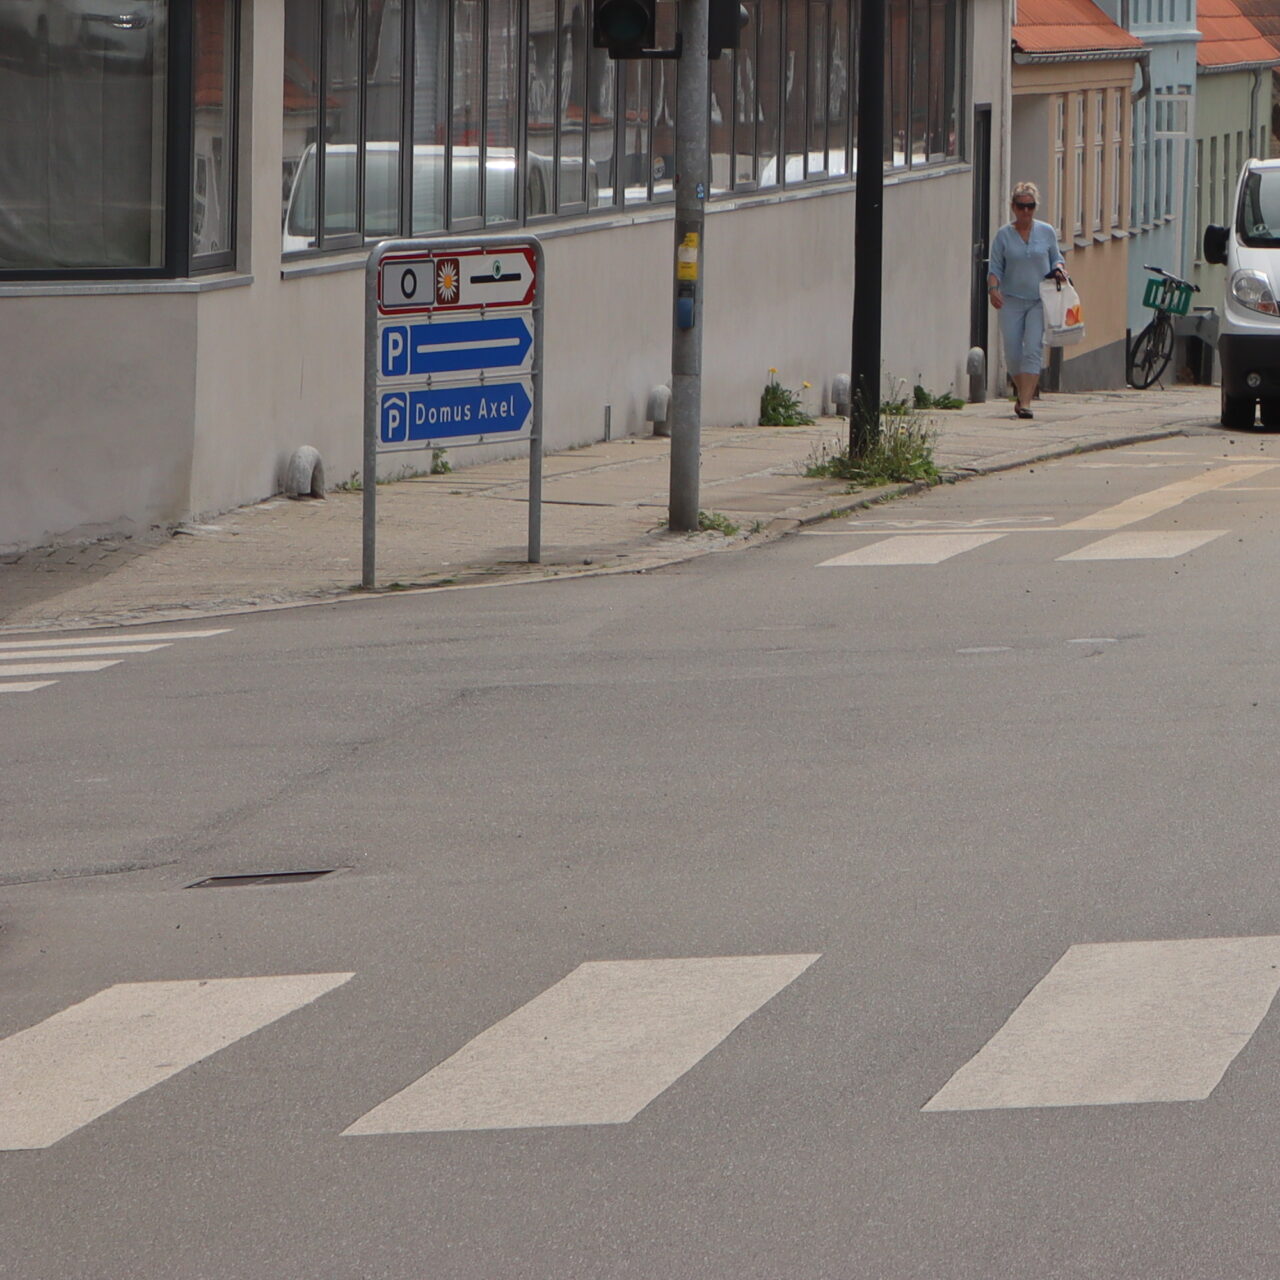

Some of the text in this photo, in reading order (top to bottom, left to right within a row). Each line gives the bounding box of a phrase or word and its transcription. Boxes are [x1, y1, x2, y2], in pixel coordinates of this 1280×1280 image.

[388, 332, 404, 371] P
[388, 395, 515, 439] P Domus Axel
